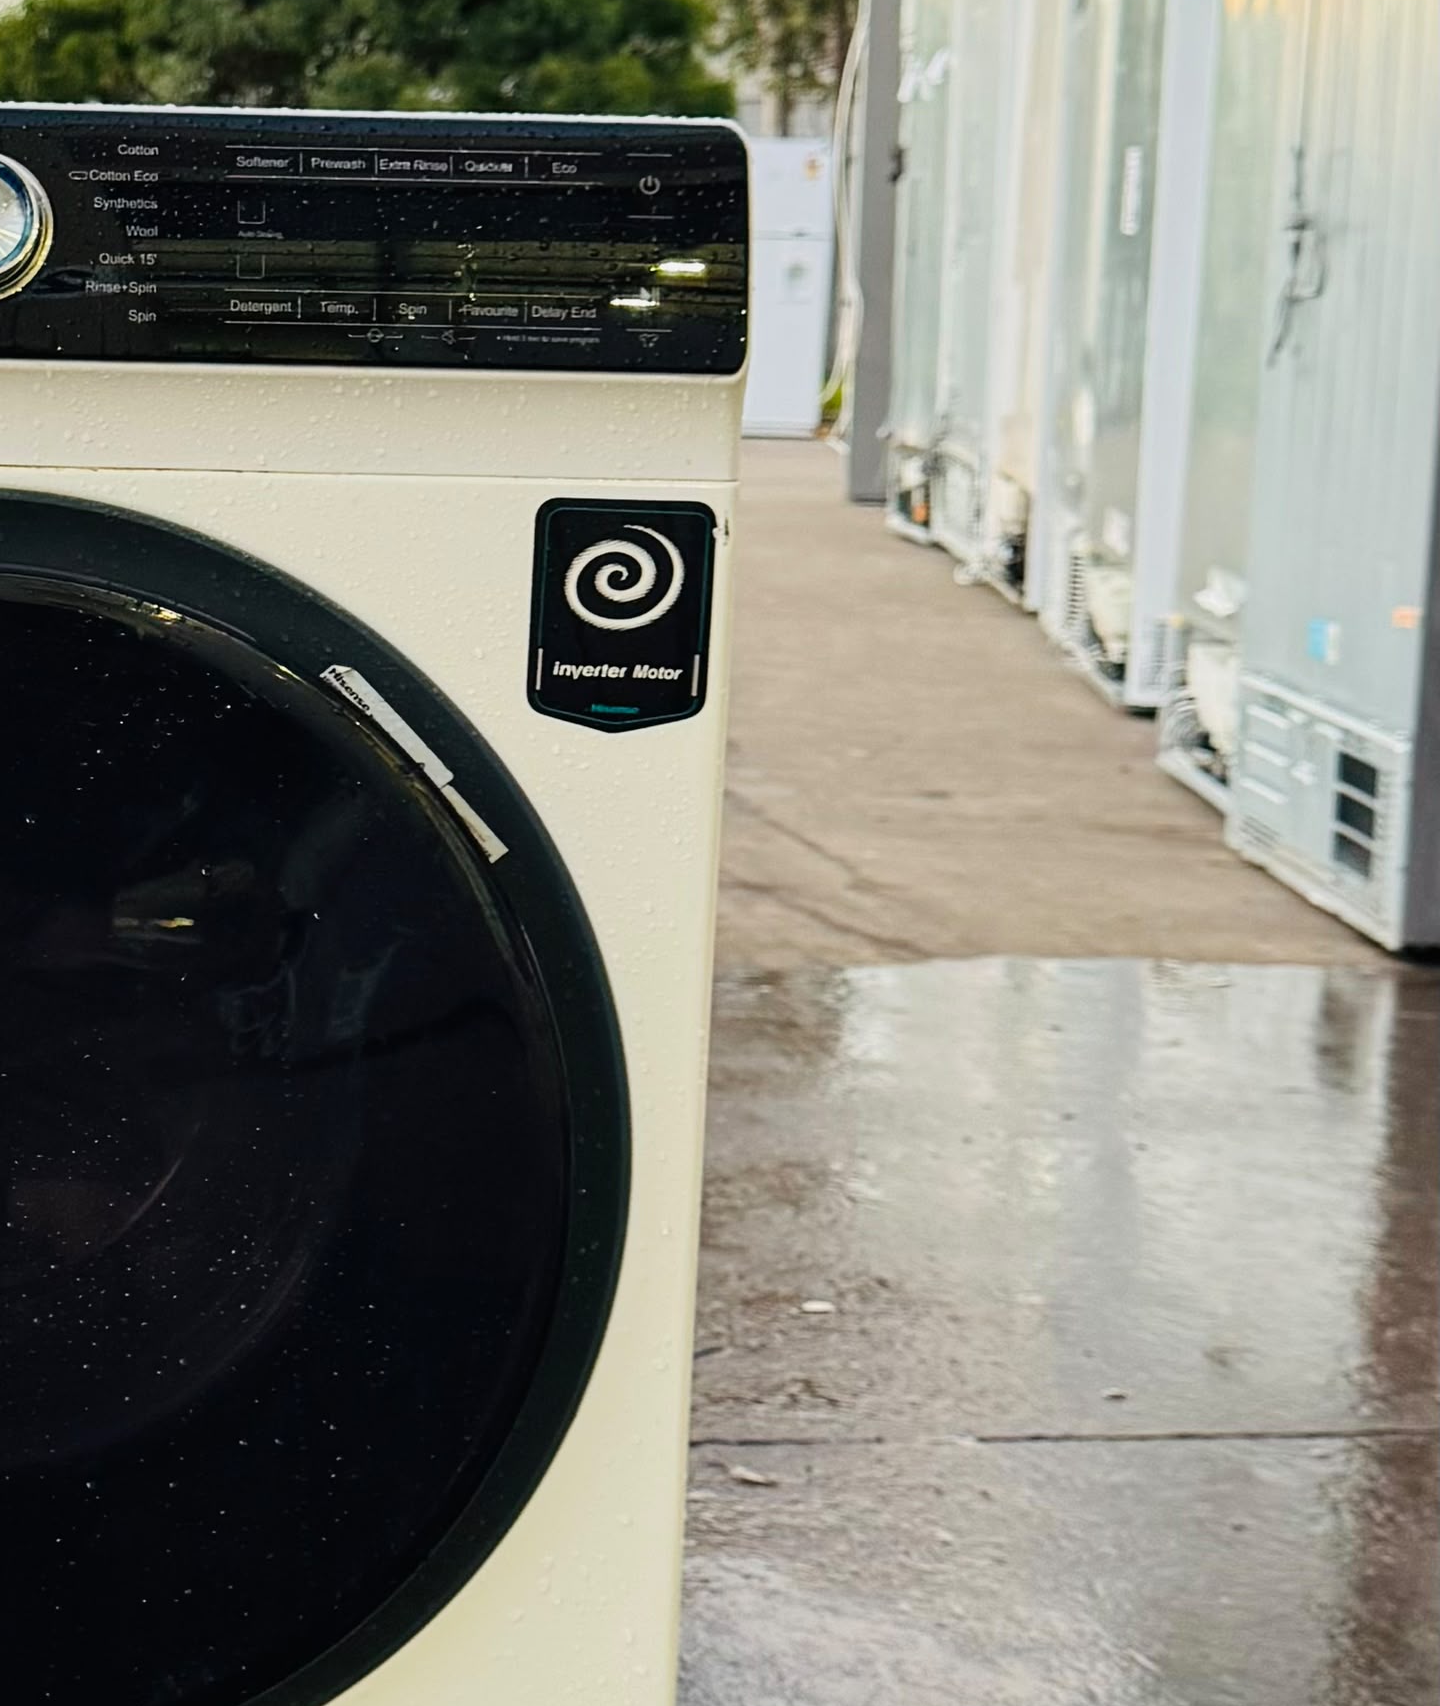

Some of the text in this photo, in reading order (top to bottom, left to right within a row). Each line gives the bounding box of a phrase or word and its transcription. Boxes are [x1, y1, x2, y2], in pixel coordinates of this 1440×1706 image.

[117, 143, 159, 156] Cotton
[235, 155, 289, 169] Softener
[310, 157, 366, 170] Prewash
[379, 158, 448, 172] Extra Rinse
[552, 162, 578, 174] Eco
[89, 169, 159, 182] Cotton Eco
[93, 196, 158, 211] Synthetics
[125, 225, 159, 237] Wool
[99, 252, 135, 265] Quick
[85, 279, 157, 296] Rinse+Spin
[229, 299, 293, 315] Detergent
[320, 301, 360, 315] Temp.
[398, 303, 428, 316] Spin
[531, 305, 597, 321] Delay End
[128, 309, 157, 324] Spin
[632, 664, 684, 681] Motor
